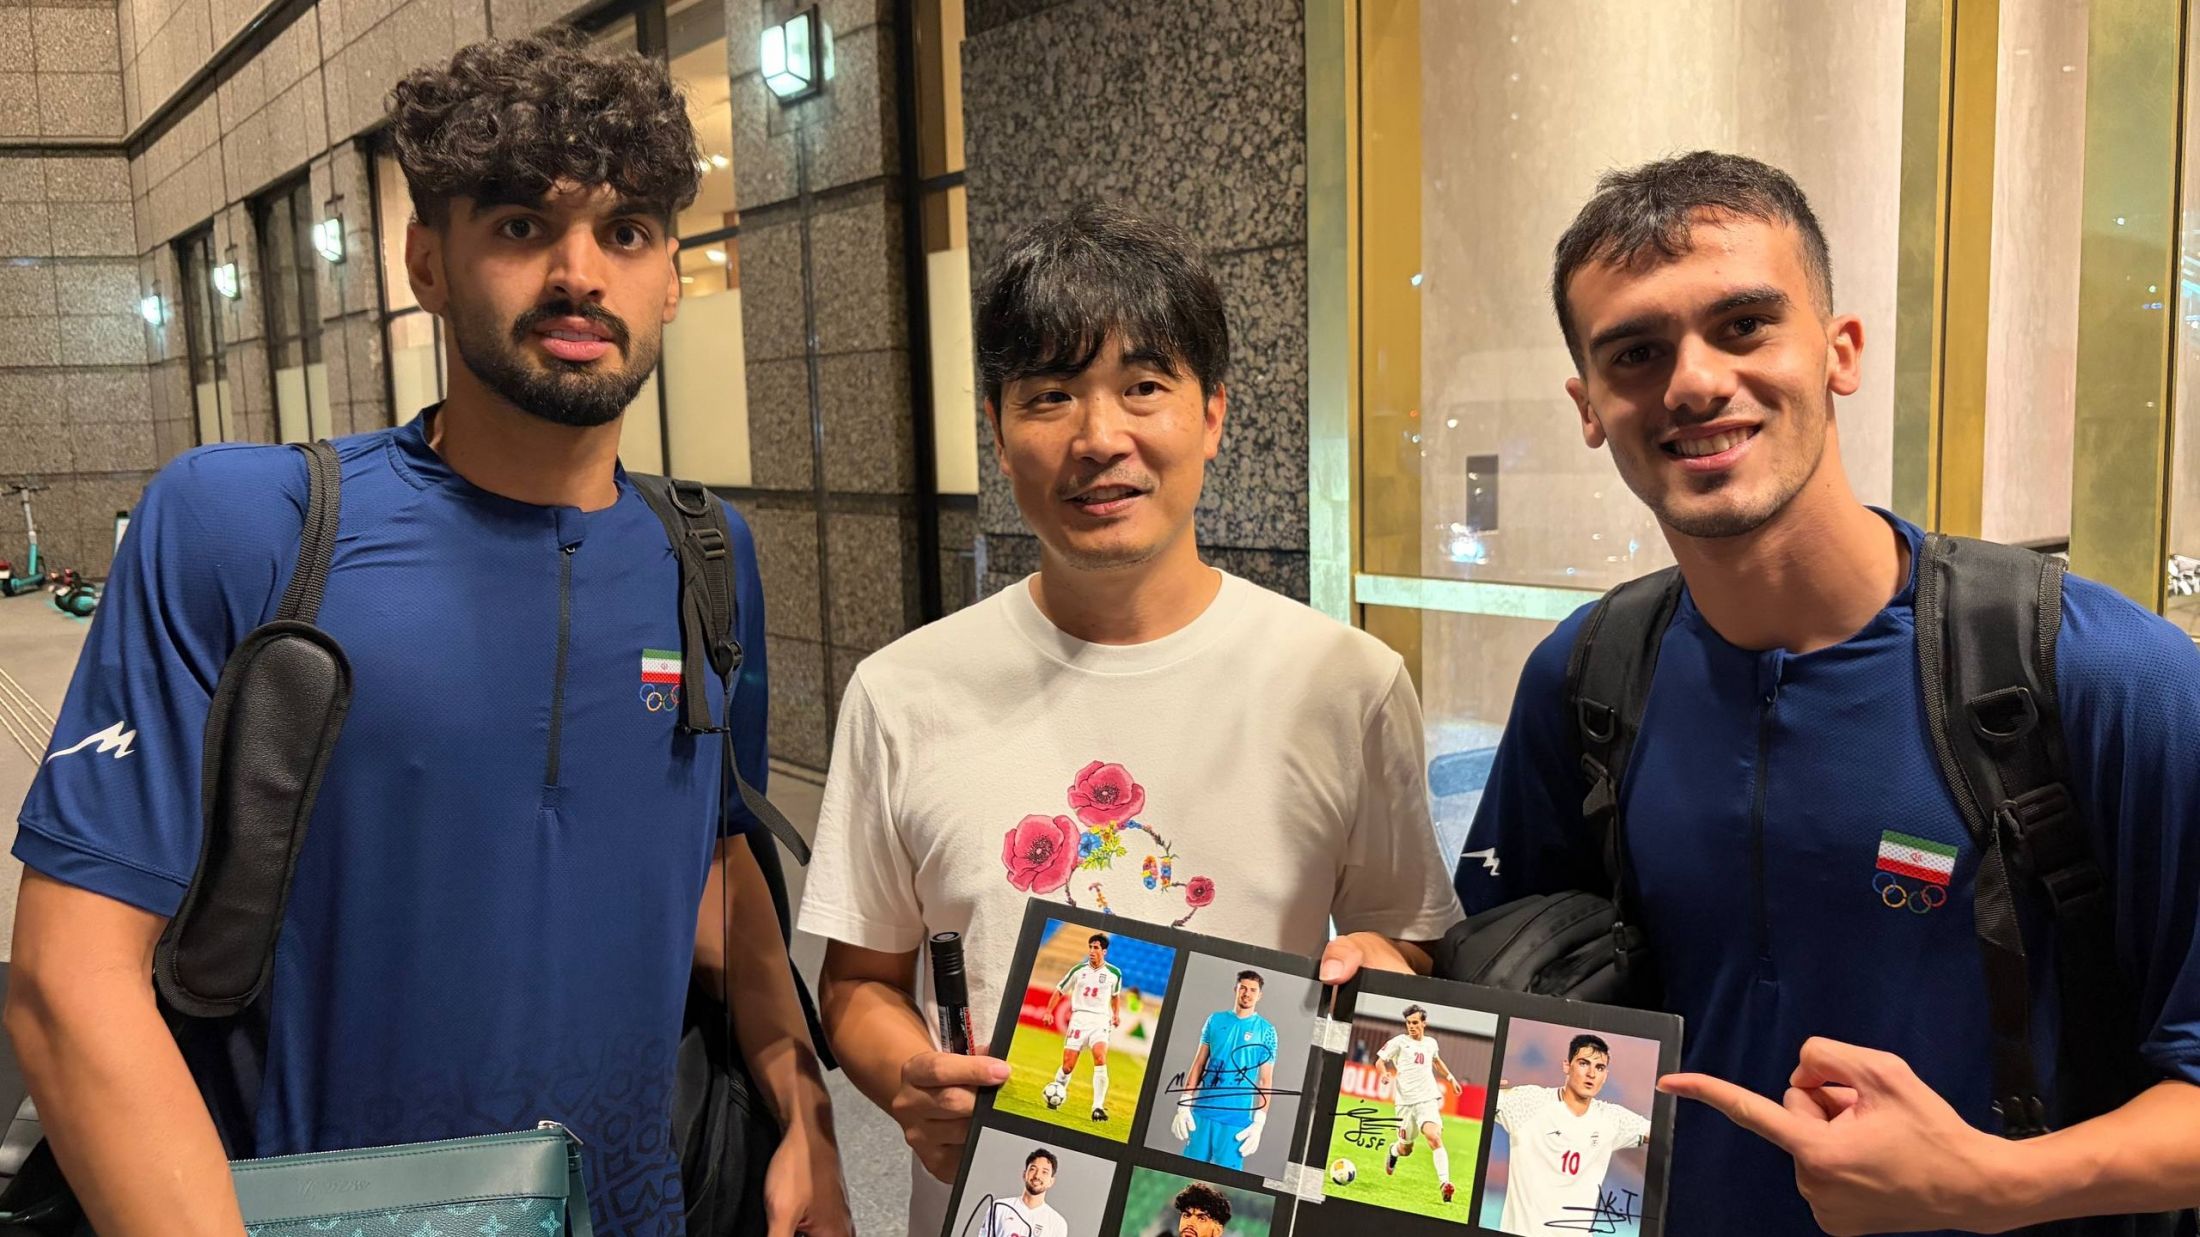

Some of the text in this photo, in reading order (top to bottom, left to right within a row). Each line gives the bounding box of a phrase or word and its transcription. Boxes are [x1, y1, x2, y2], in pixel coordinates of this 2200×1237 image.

[1083, 986, 1099, 998] 28
[1414, 1051, 1425, 1065] 20
[1561, 1150, 1581, 1175] 10
